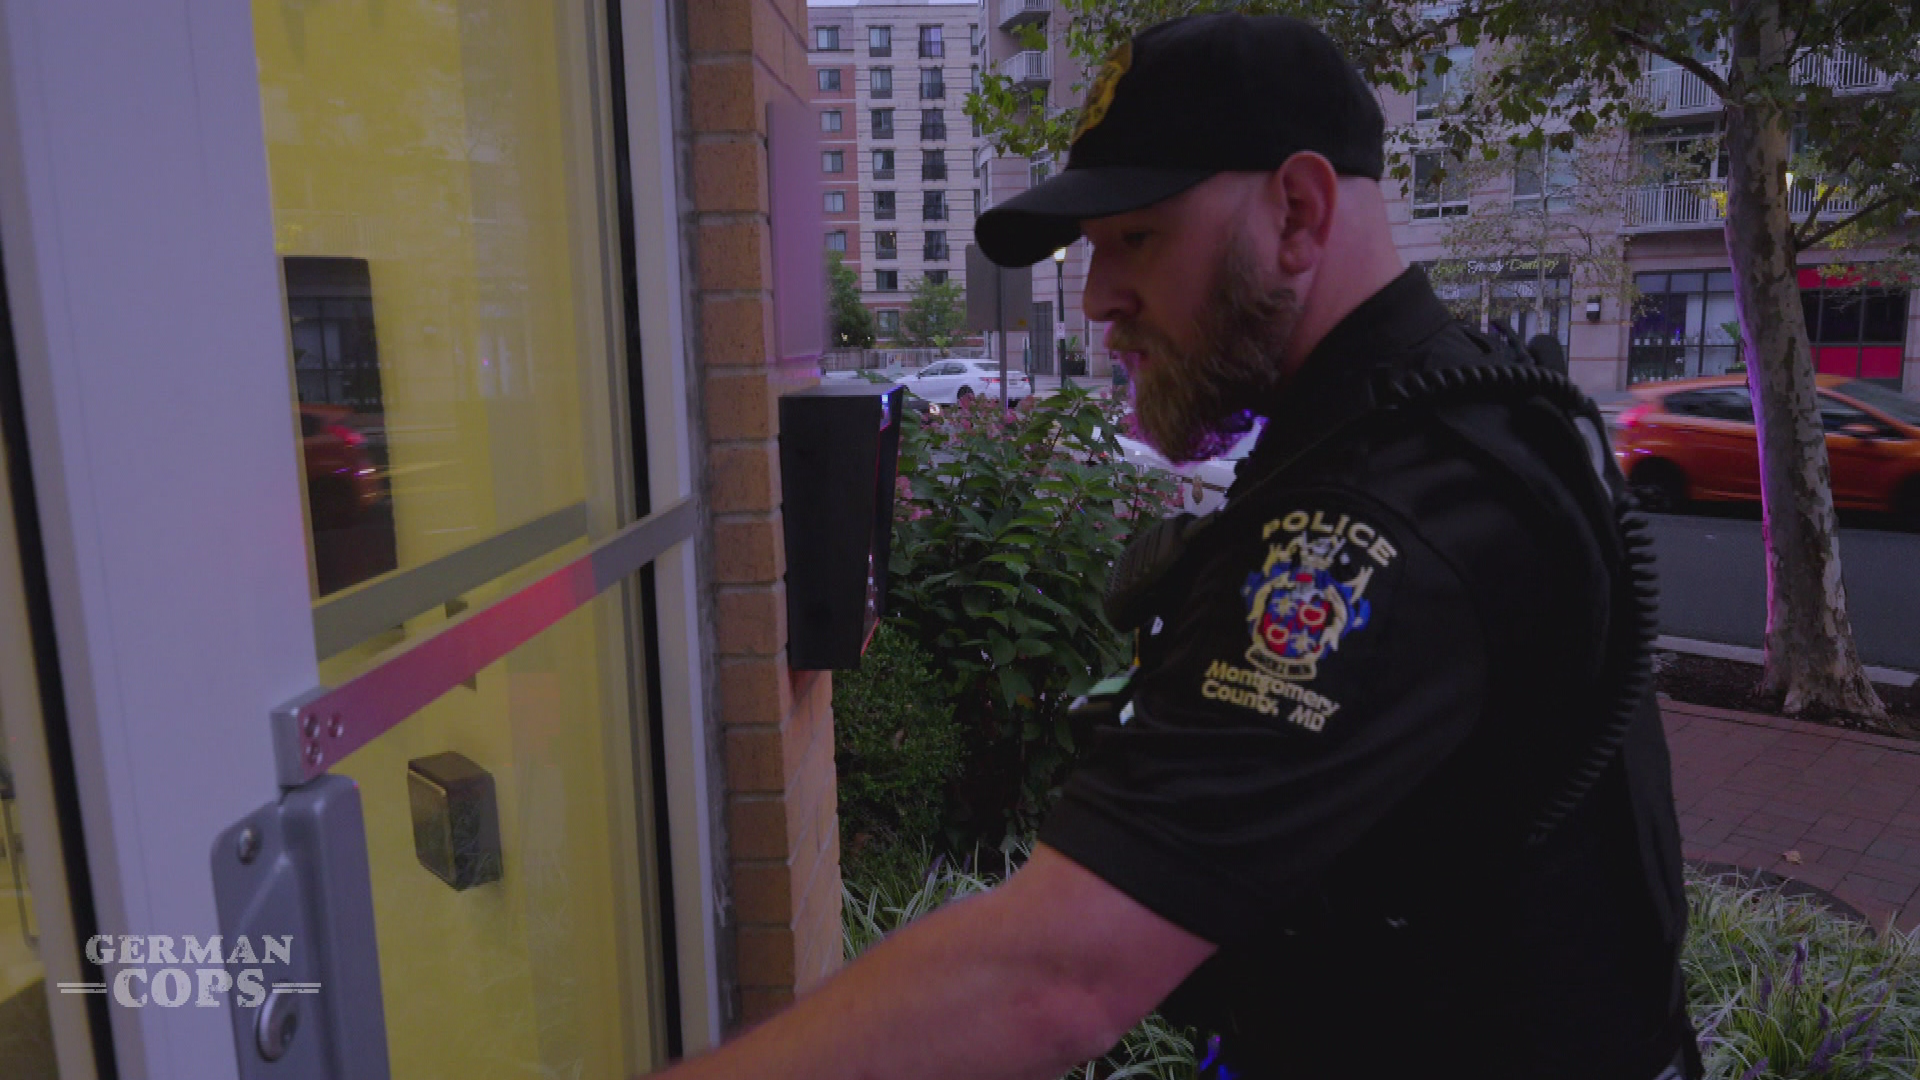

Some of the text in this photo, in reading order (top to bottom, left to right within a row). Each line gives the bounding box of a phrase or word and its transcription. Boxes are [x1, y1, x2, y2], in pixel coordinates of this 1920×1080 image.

[1262, 510, 1398, 568] POLICE
[1204, 659, 1341, 716] Montgomery
[1287, 705, 1326, 733] MD
